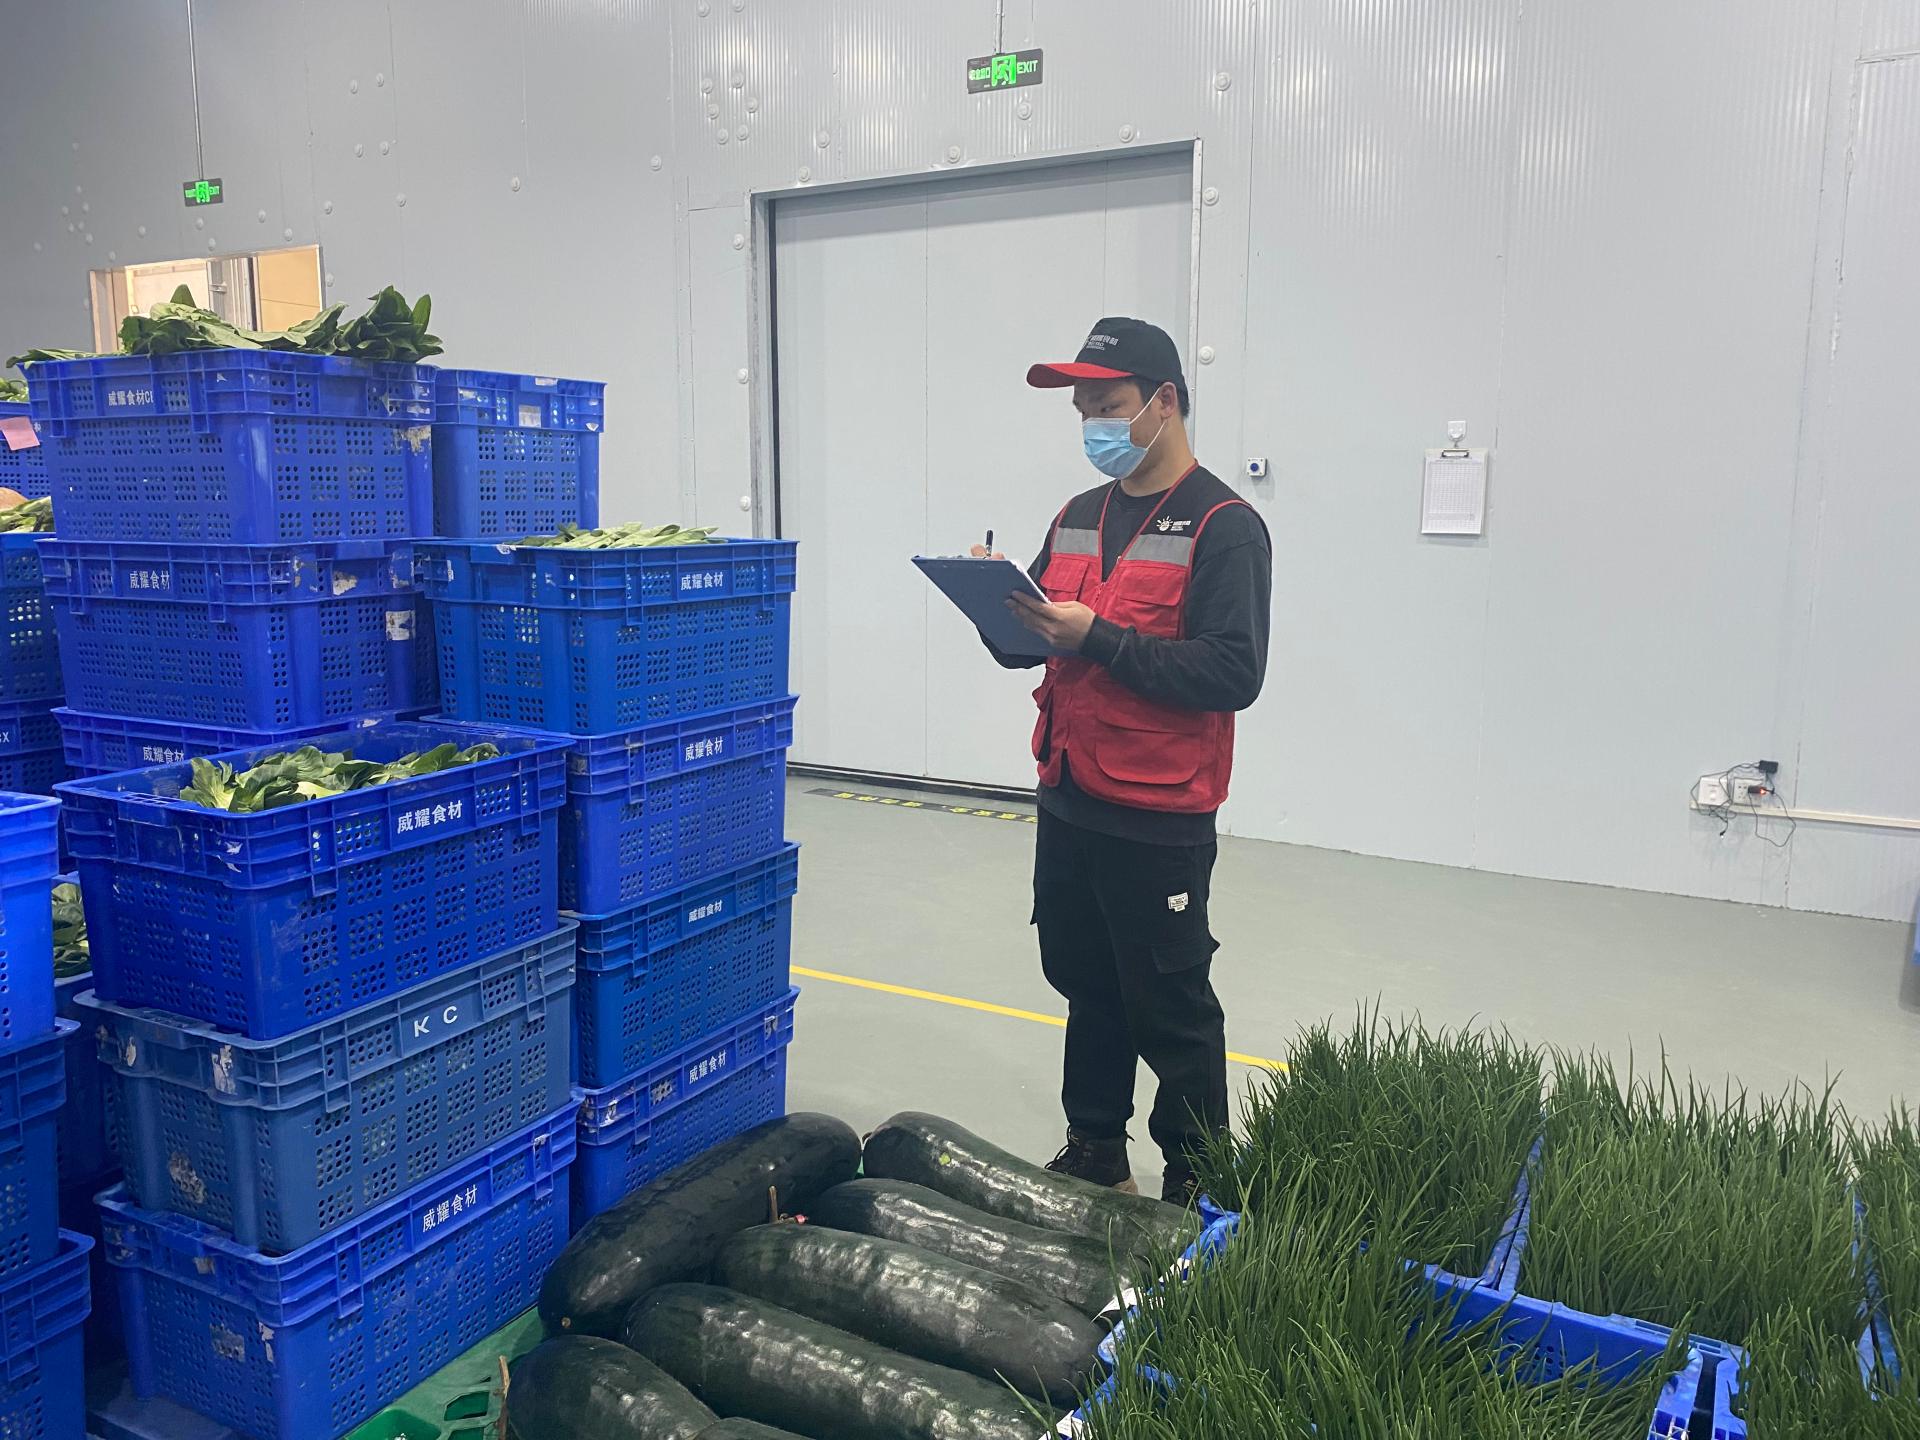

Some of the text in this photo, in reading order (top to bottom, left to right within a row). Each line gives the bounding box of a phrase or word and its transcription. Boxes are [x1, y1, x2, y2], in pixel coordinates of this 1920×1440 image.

[1016, 60, 1038, 74] EXIT
[681, 571, 724, 591] 威耀食材
[0, 731, 10, 743] X
[685, 735, 723, 762] 威耀食材
[397, 799, 463, 835] 威耀食材
[413, 1005, 458, 1038] K C
[422, 1184, 478, 1233] 威耀食材
